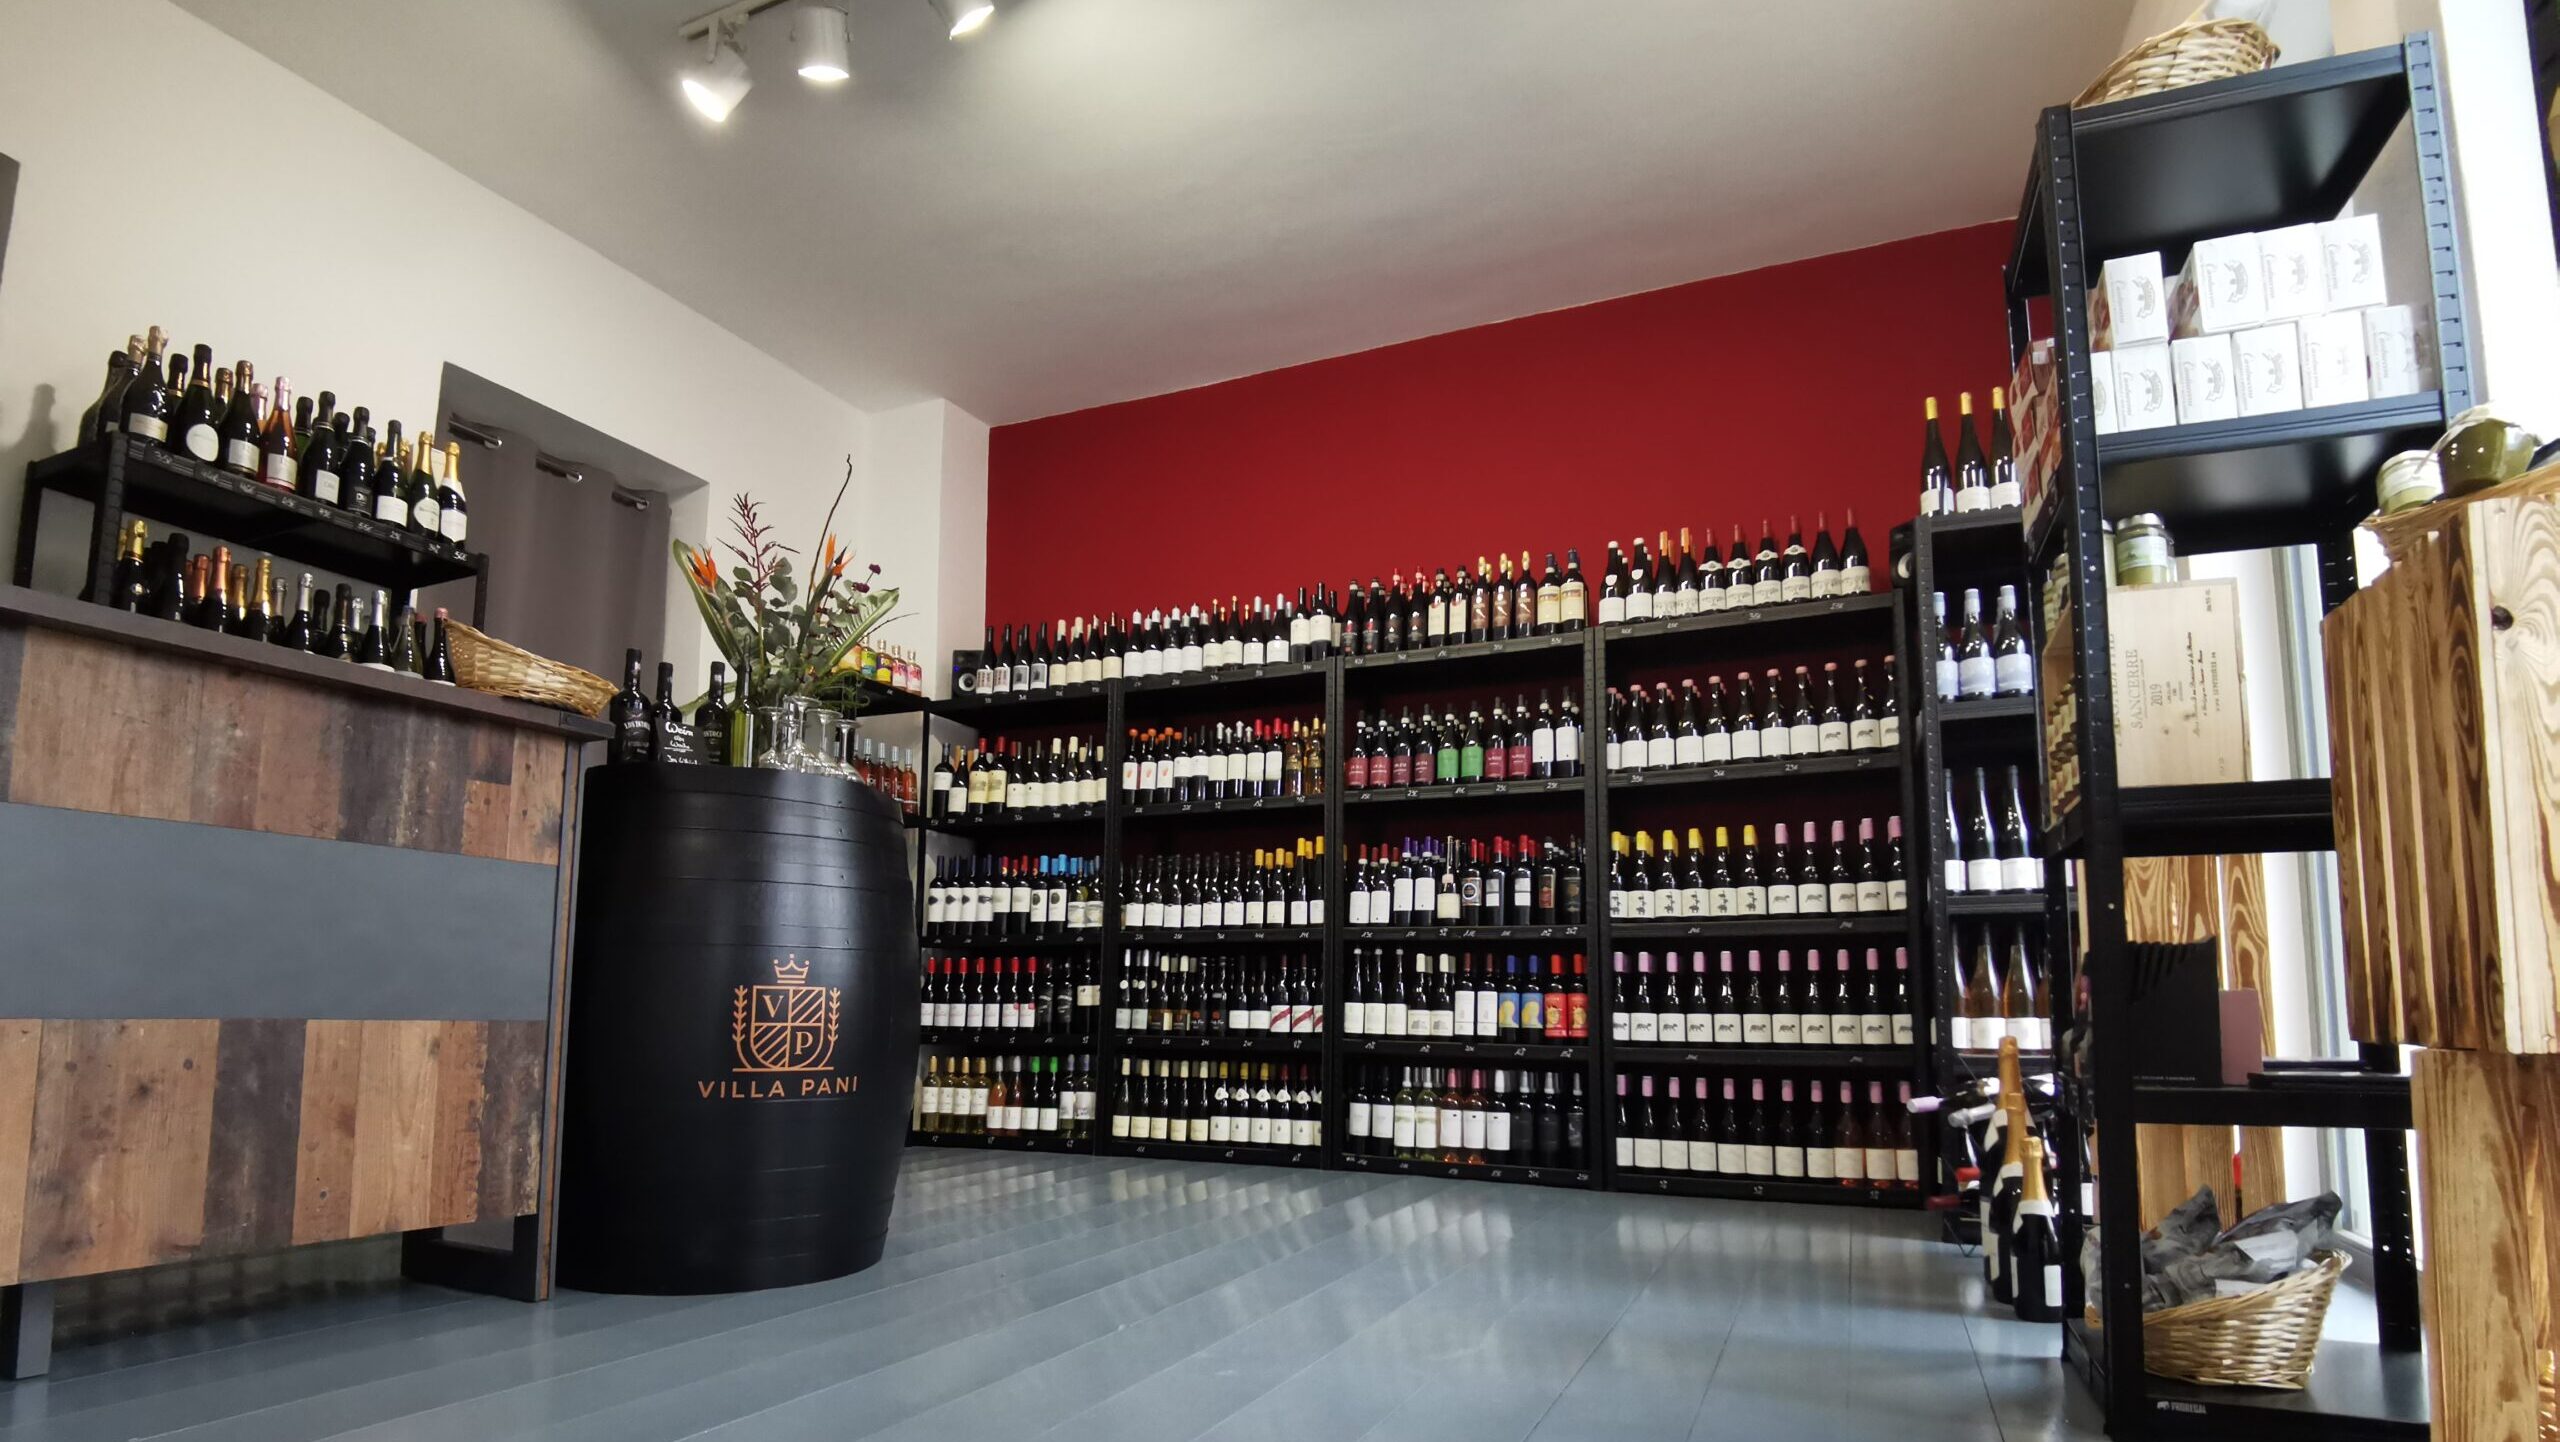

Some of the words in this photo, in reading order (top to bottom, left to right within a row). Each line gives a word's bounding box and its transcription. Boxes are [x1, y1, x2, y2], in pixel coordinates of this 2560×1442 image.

[2125, 648, 2144, 729] SANCERRE
[2150, 683, 2163, 707] 2019
[762, 994, 784, 1018] V
[794, 1031, 814, 1055] P
[697, 1080, 786, 1100] VILLA
[801, 1075, 858, 1096] PANI
